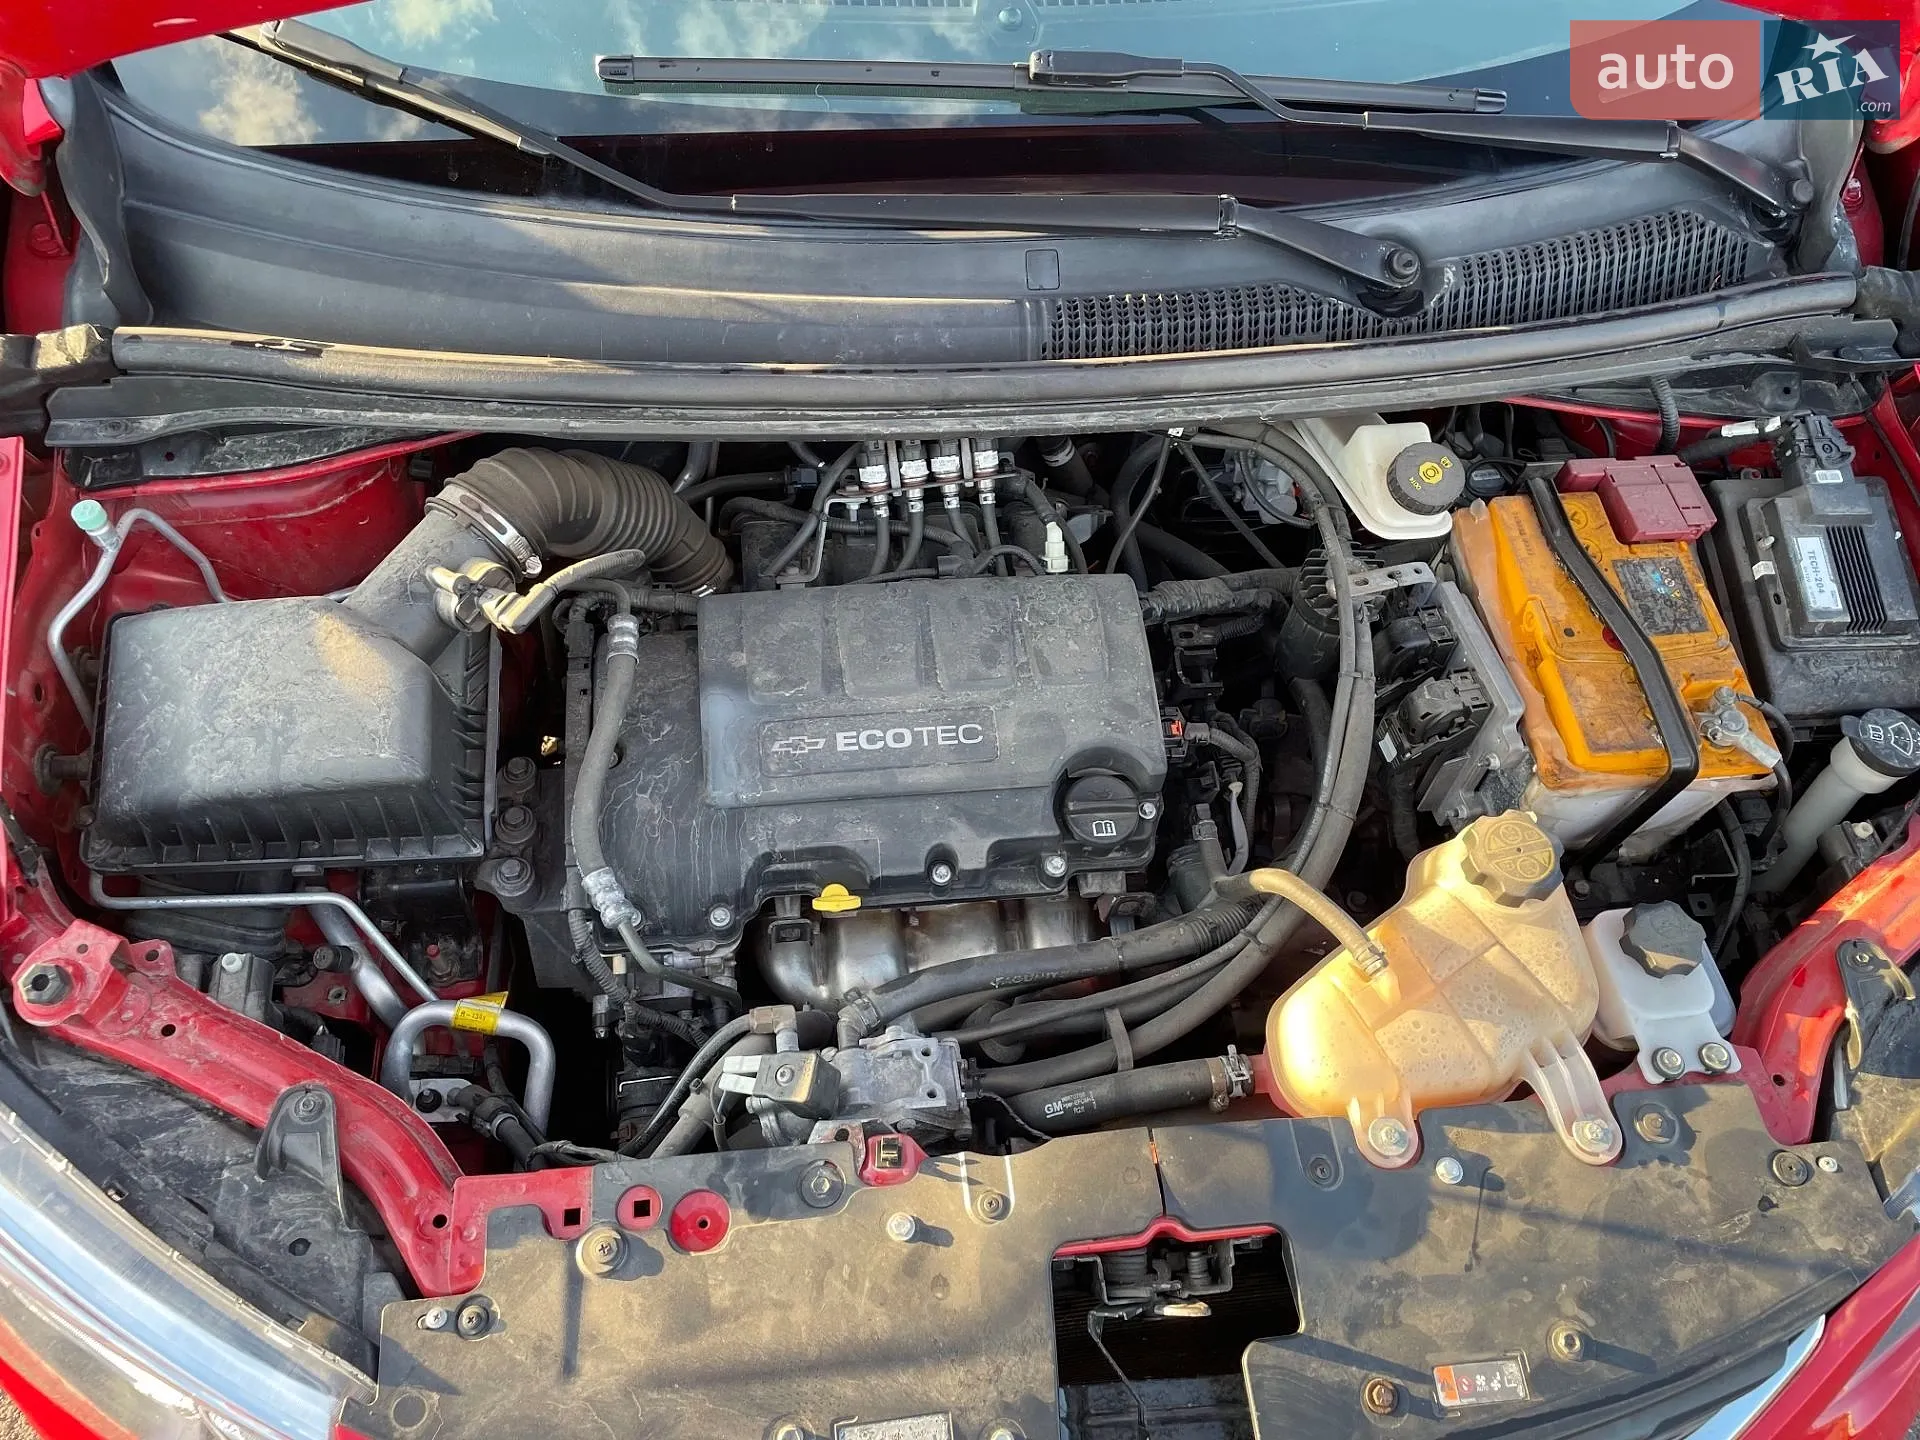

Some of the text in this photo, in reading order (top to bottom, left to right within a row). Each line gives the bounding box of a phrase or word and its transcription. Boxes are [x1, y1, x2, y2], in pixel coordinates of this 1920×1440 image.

[1807, 550, 1826, 593] TECH-204
[836, 723, 984, 752] ECOTEC
[1044, 1100, 1064, 1114] GM
